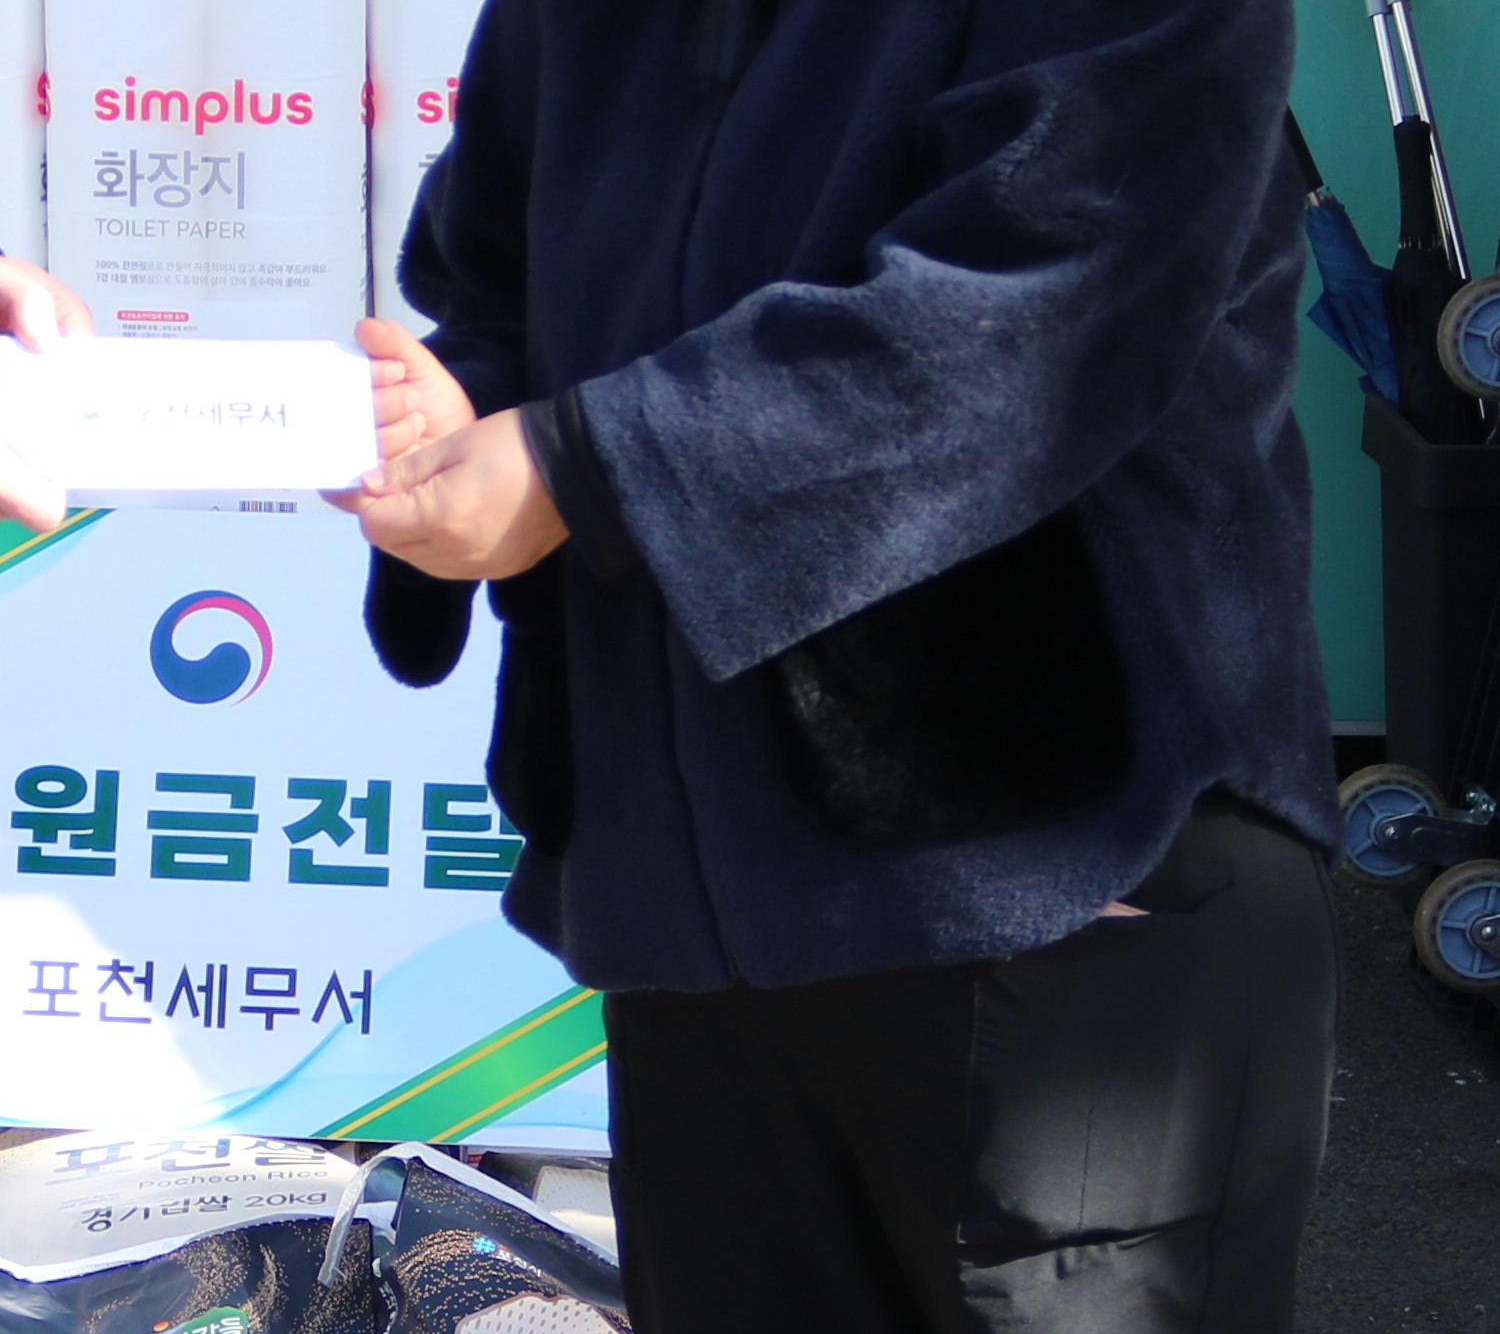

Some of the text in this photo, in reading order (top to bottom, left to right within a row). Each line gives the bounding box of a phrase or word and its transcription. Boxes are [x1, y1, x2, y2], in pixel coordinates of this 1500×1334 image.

[93, 76, 315, 135] simplus
[93, 149, 248, 211] 화장지
[95, 218, 246, 239] TOILET PAPER
[23, 959, 373, 1035] 포천세무서
[138, 1172, 256, 1190] Pocheon
[244, 1191, 327, 1208] 20kg
